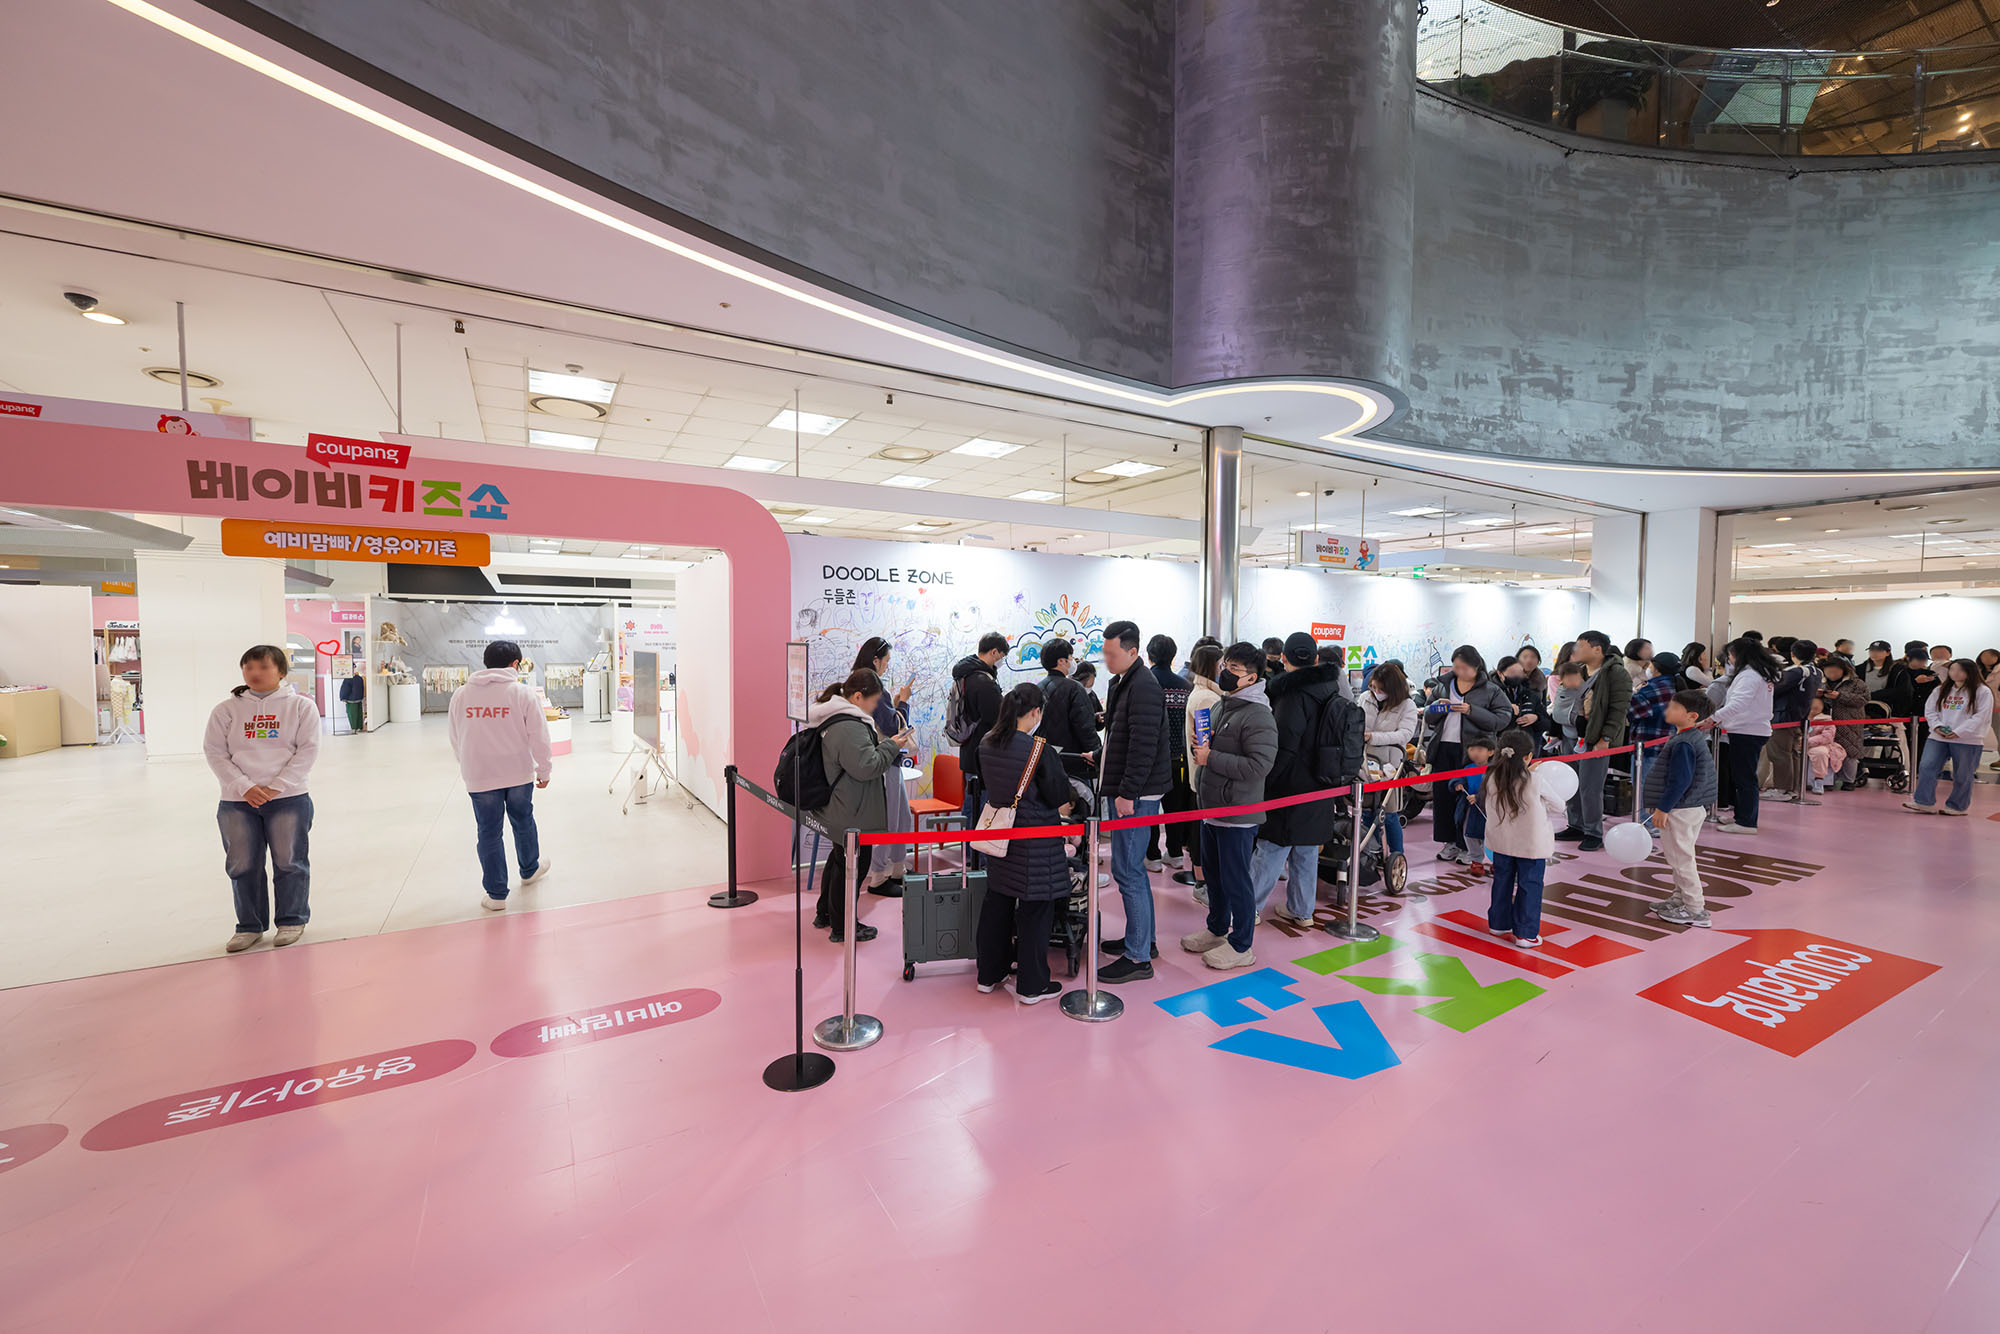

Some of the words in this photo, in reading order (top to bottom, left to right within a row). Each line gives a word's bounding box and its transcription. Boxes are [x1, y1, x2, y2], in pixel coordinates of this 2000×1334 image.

[0, 404, 36, 416] upang
[316, 440, 399, 464] coupang
[186, 459, 511, 520] 베이비키즈쇼
[823, 565, 900, 583] DOODLE
[907, 568, 954, 585] ZONE
[823, 588, 857, 605] 두들존
[1313, 626, 1342, 638] coupang
[465, 706, 511, 719] STAFF
[244, 721, 280, 730] 베이비
[245, 729, 279, 739] 키즈쇼
[1681, 943, 1873, 1029] coupang
[537, 999, 683, 1044] 예비맘빠
[164, 1055, 417, 1127] 영유아기존
